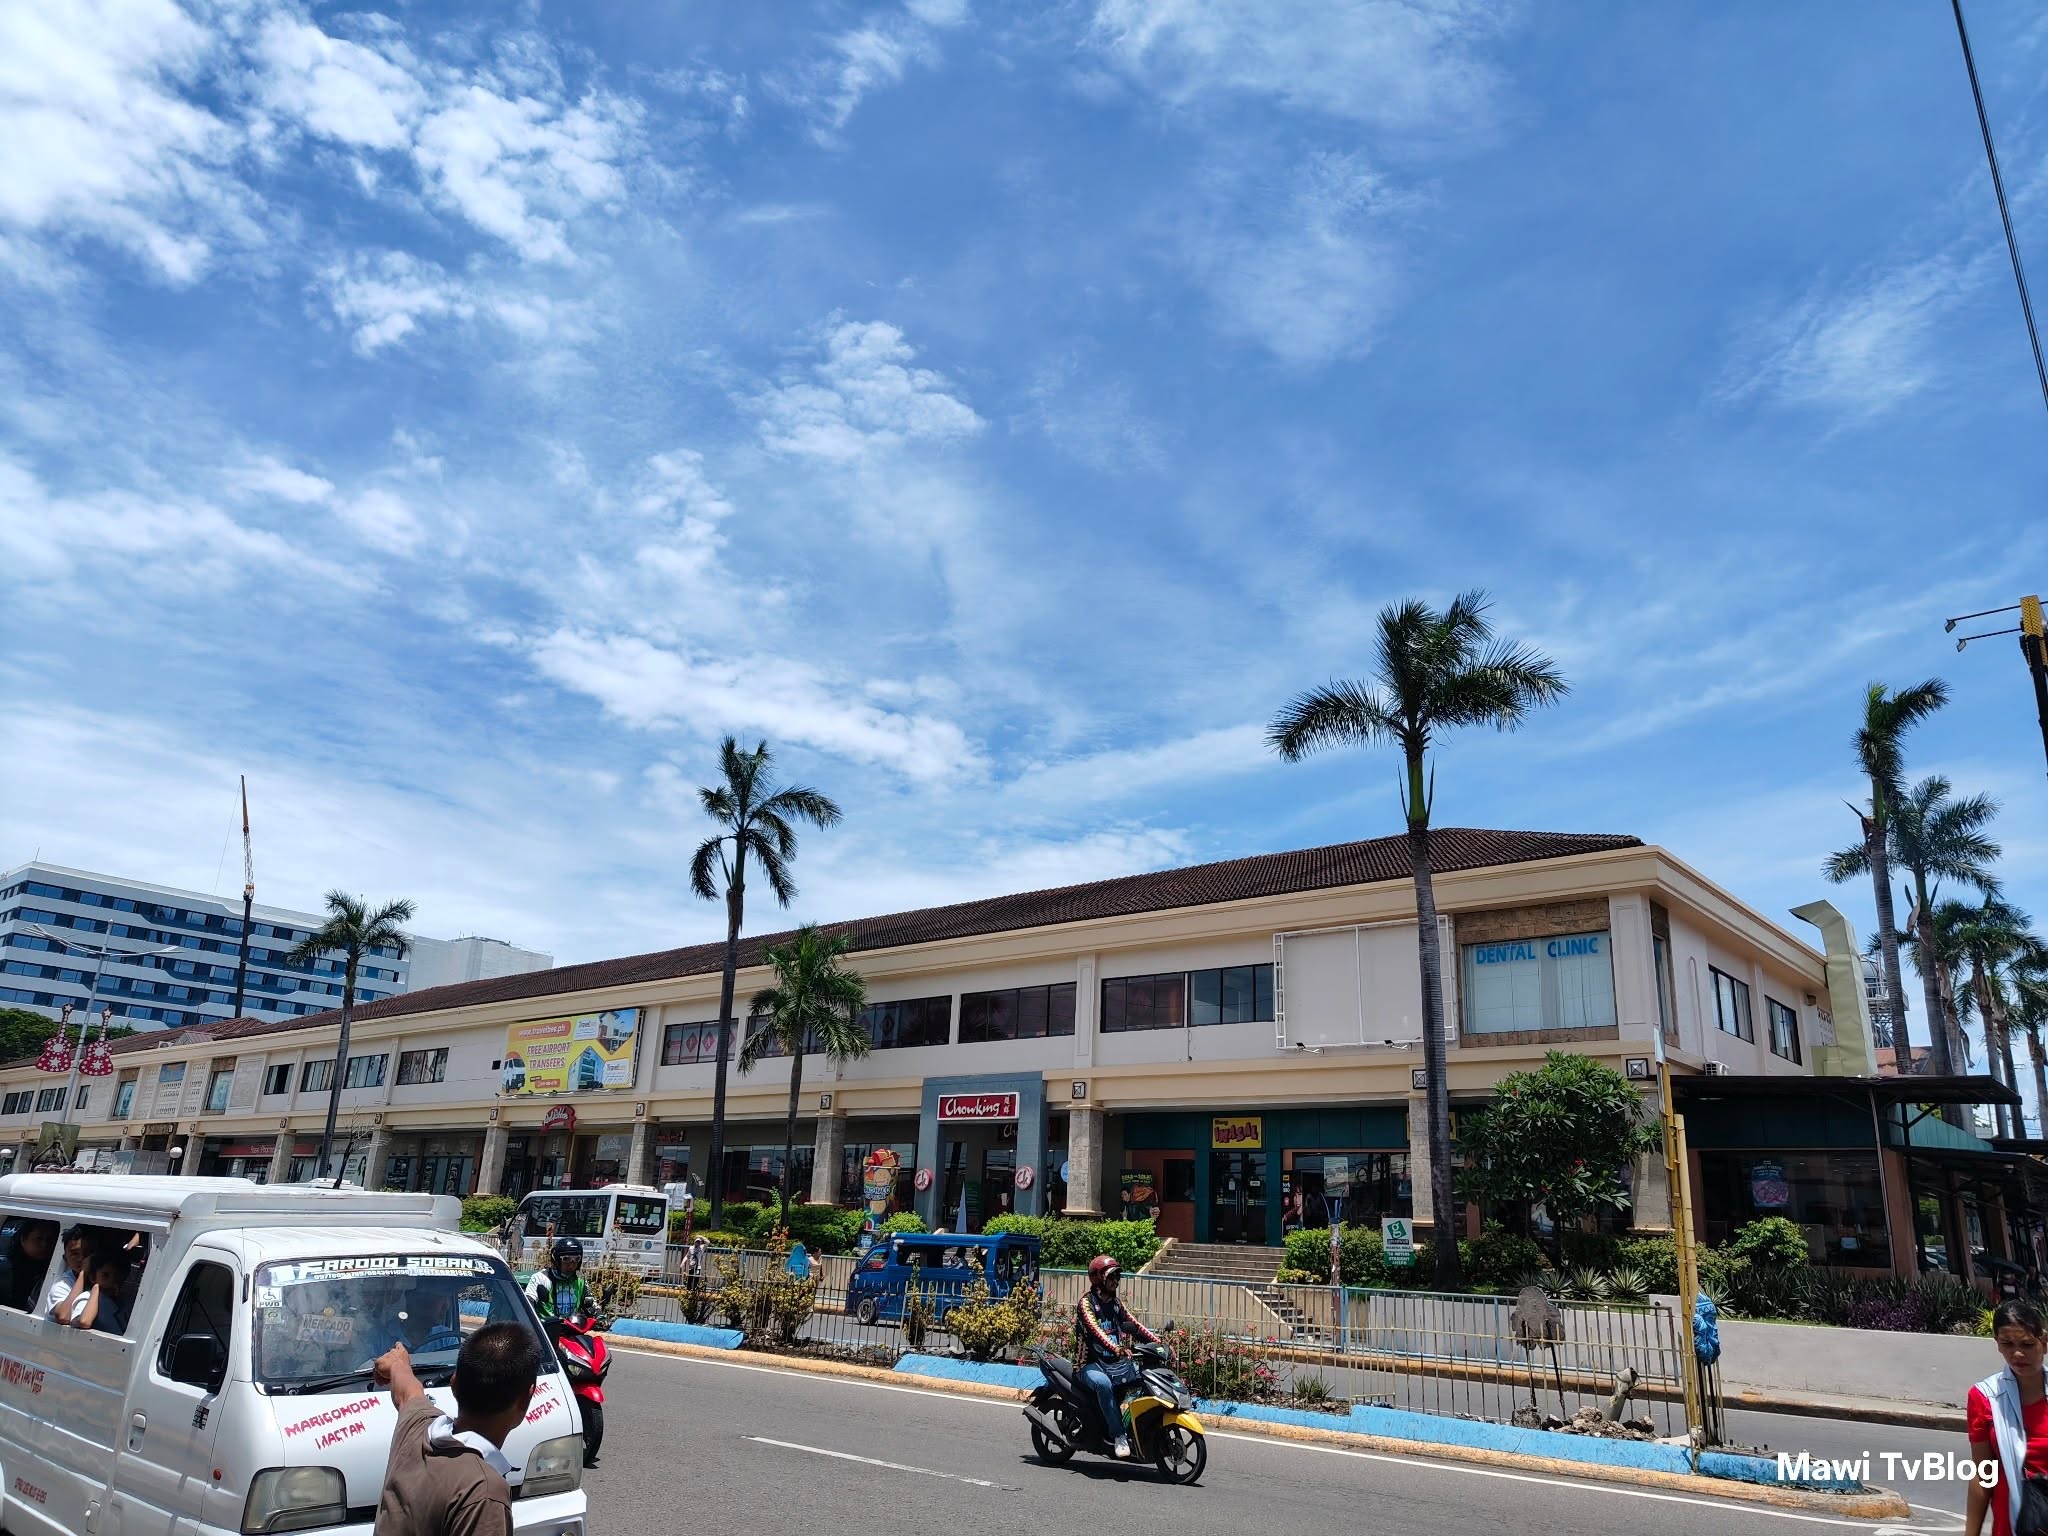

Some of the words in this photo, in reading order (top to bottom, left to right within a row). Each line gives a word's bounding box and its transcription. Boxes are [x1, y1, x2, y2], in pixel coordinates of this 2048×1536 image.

[1476, 944, 1536, 964] DENTAL
[1547, 937, 1598, 958] CLINIC
[527, 1044, 542, 1055] FREE
[543, 1042, 571, 1053] AIRPORT
[529, 1057, 565, 1069] TRANSFERS
[945, 1097, 1001, 1116] Chowking
[407, 1257, 473, 1269] SOBAN
[302, 1315, 351, 1332] MERCADO
[284, 1396, 381, 1438] MARIGONDON
